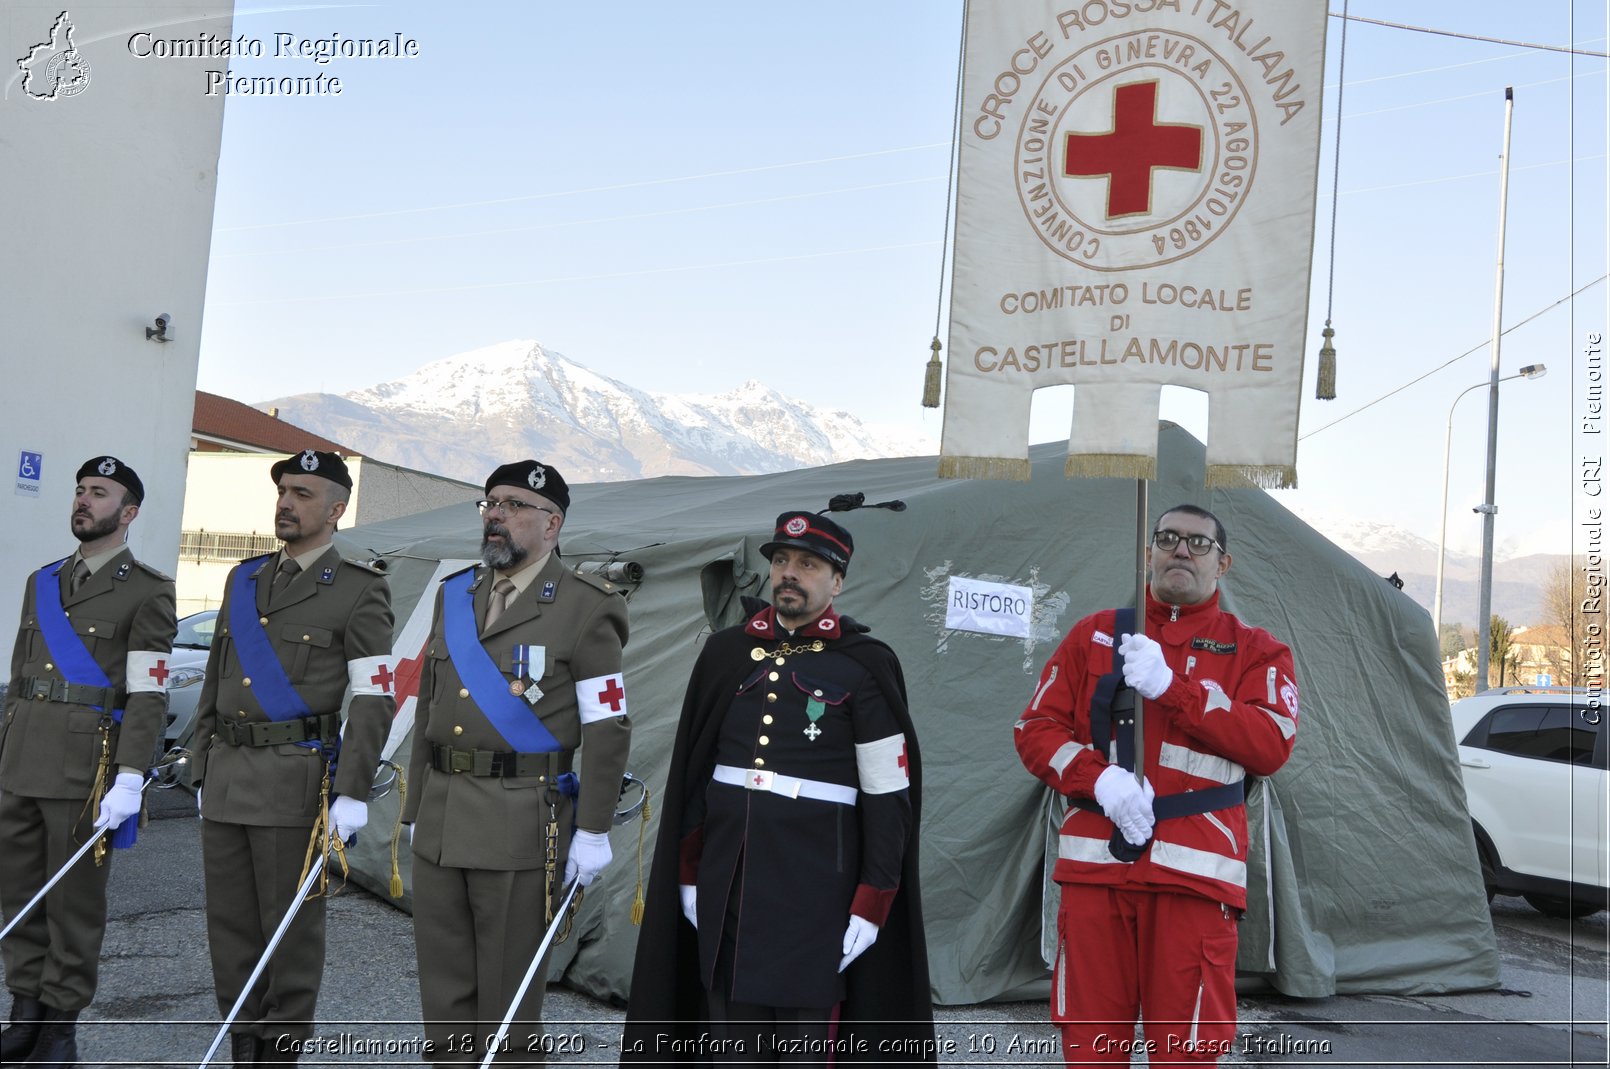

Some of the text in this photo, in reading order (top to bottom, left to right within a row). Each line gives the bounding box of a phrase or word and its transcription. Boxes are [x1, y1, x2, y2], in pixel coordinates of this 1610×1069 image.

[973, 31, 1054, 141] CROCE
[1191, 0, 1306, 126] ITALIANA
[1022, 34, 1250, 259] CONVENZIONE DI GINEVRA 22 AGOSTO 1864
[999, 281, 1252, 315] COMITATO LOCALE
[1110, 314, 1130, 332] DI
[974, 337, 1275, 373] CASTELLAMONTE
[953, 590, 1026, 616] RISTORO
